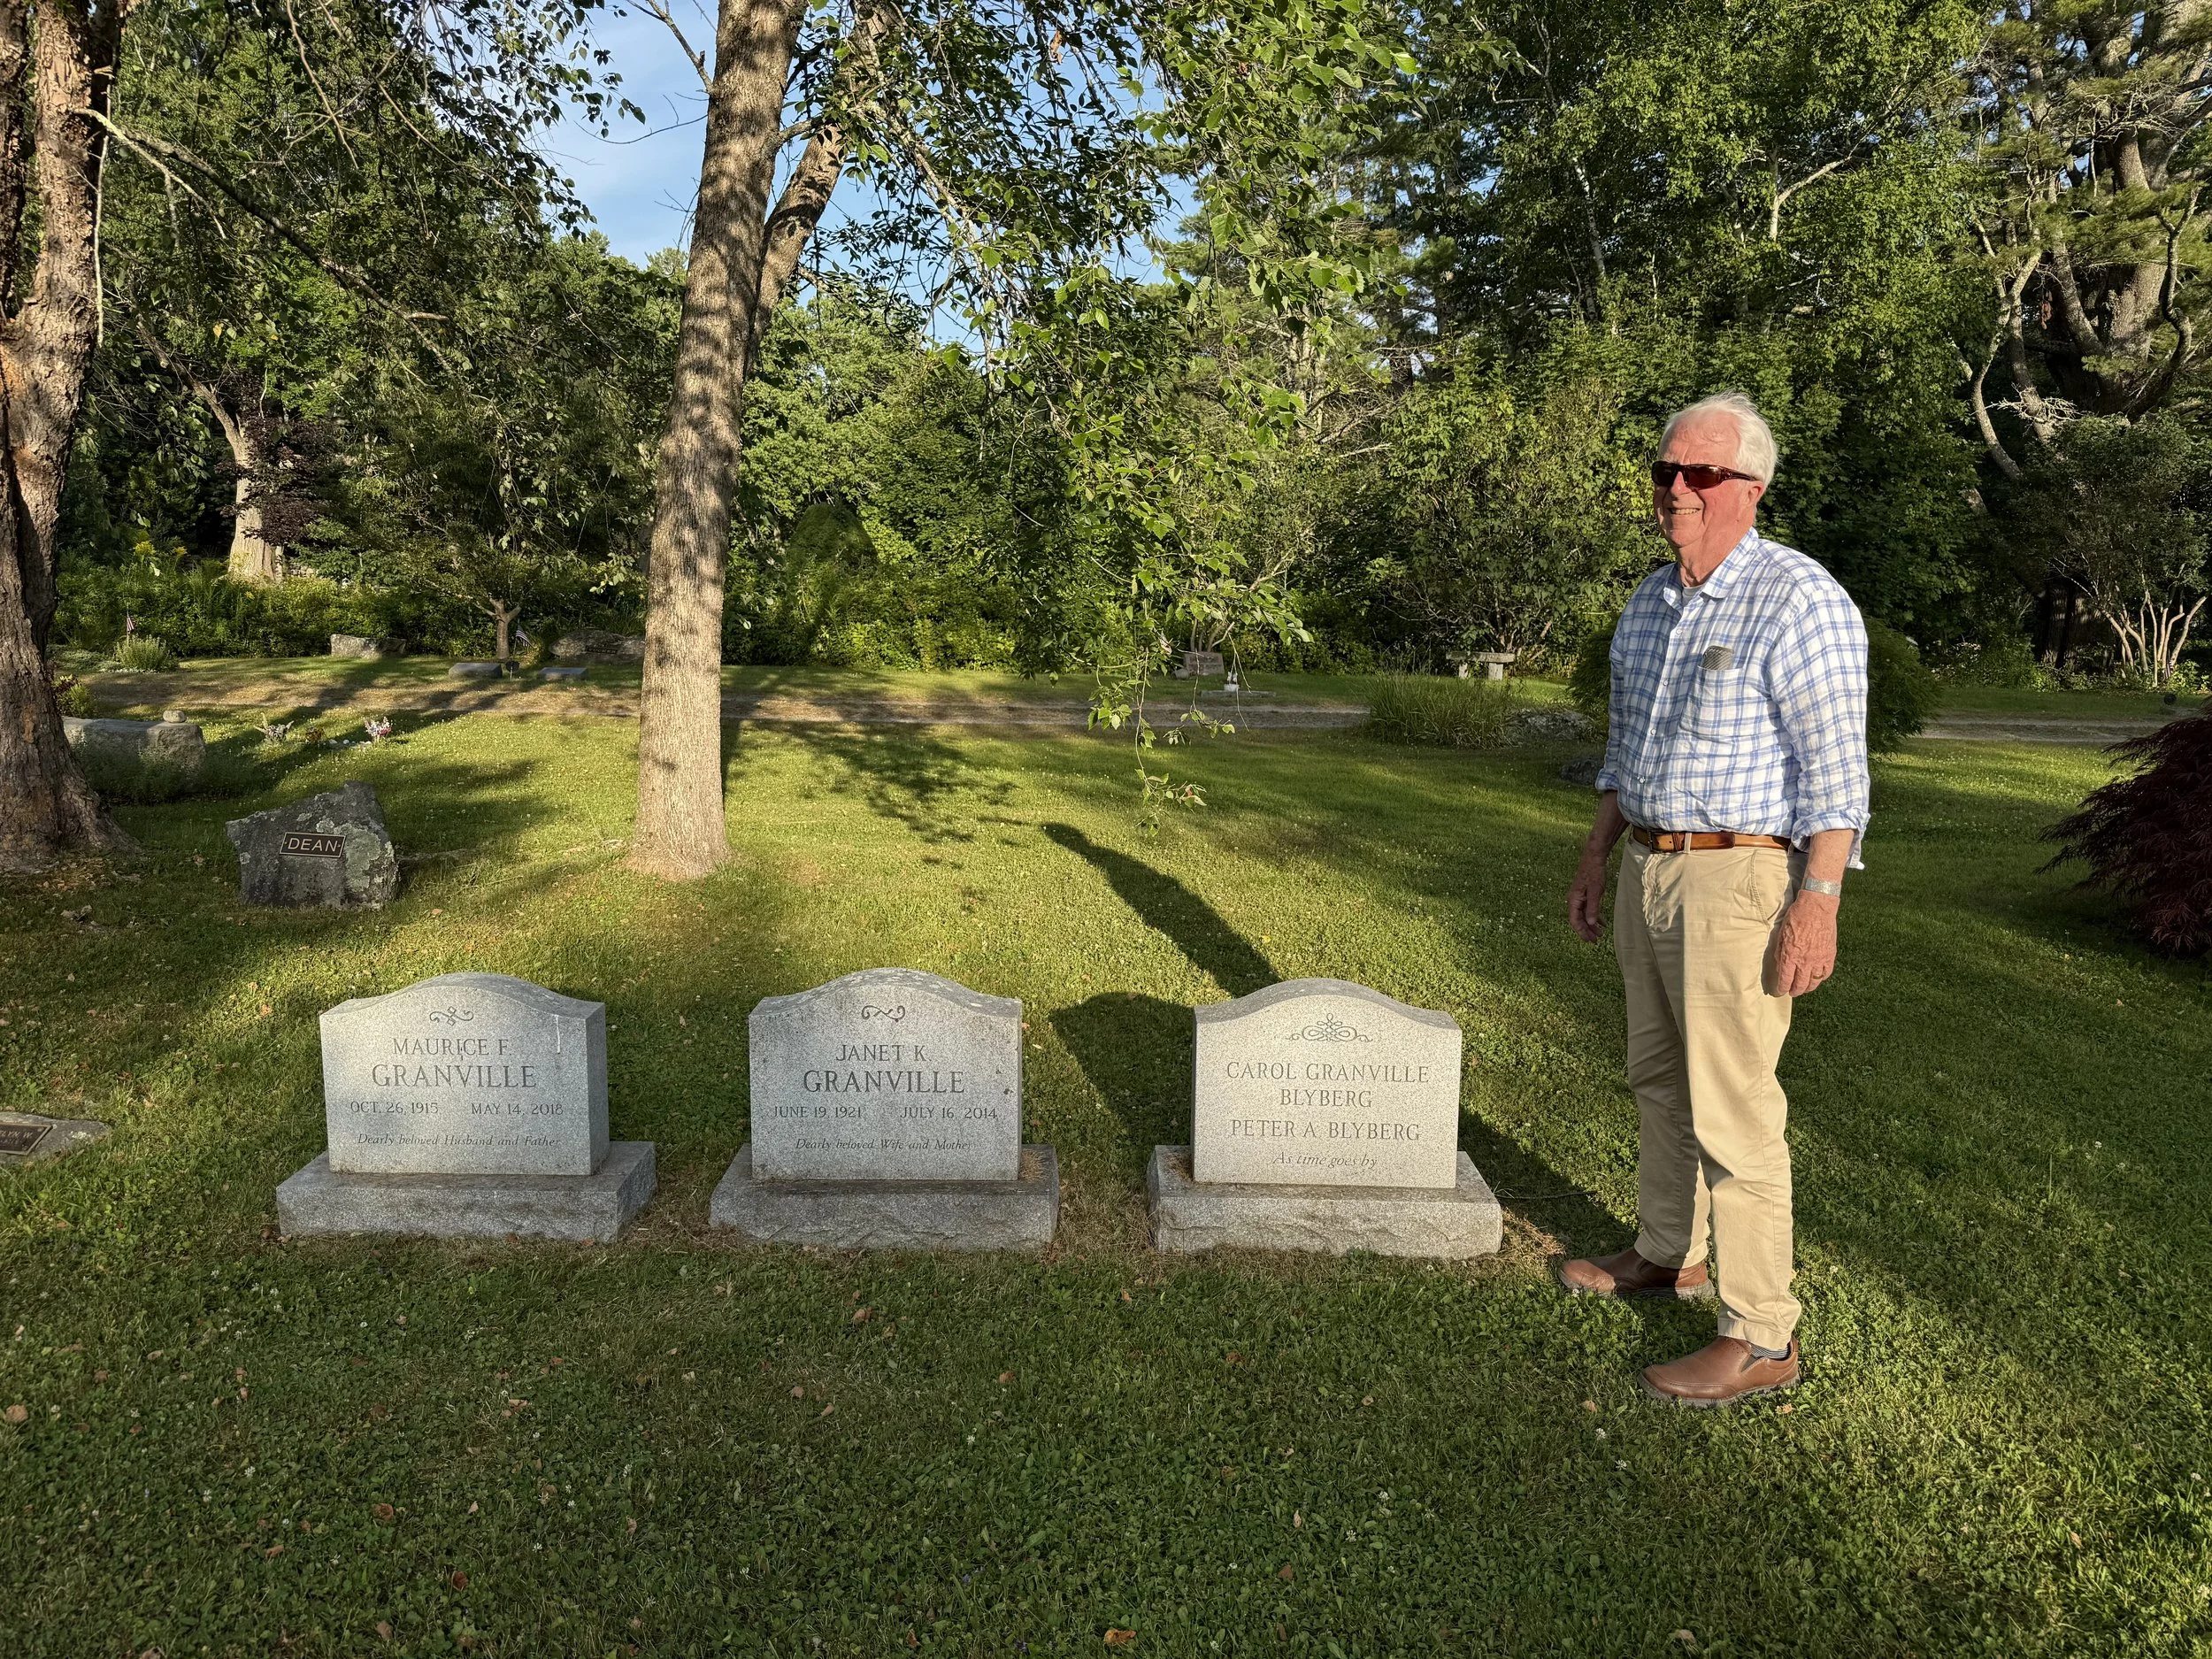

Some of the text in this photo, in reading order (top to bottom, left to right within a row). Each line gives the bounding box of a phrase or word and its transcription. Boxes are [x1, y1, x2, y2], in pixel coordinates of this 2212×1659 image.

[288, 837, 339, 852] DEAN
[393, 1038, 512, 1056] MAURICE F.
[835, 1044, 904, 1062] JANET
[372, 1064, 536, 1087] GRANVILLE
[1226, 1062, 1429, 1083] CAROL GRANVILLE
[803, 1070, 964, 1093] GRANVILLE
[1280, 1088, 1372, 1107] BLYBERG
[350, 1101, 382, 1113] OCT.
[411, 1102, 439, 1114] 1915
[471, 1102, 564, 1117] MAY 14, 2018
[773, 1106, 808, 1118] JUNE
[834, 1106, 862, 1118] 1921
[900, 1107, 934, 1118] JULY
[964, 1107, 997, 1119] 2014
[1231, 1119, 1296, 1138] PETER
[1328, 1121, 1420, 1141] BLYBERG
[357, 1133, 560, 1147] Dearly beloved Husband and Father
[795, 1138, 831, 1150] Dearly
[836, 1138, 875, 1149] beloved
[880, 1139, 903, 1151] Wife
[908, 1139, 930, 1149] and
[1273, 1151, 1378, 1168] As time goes by
